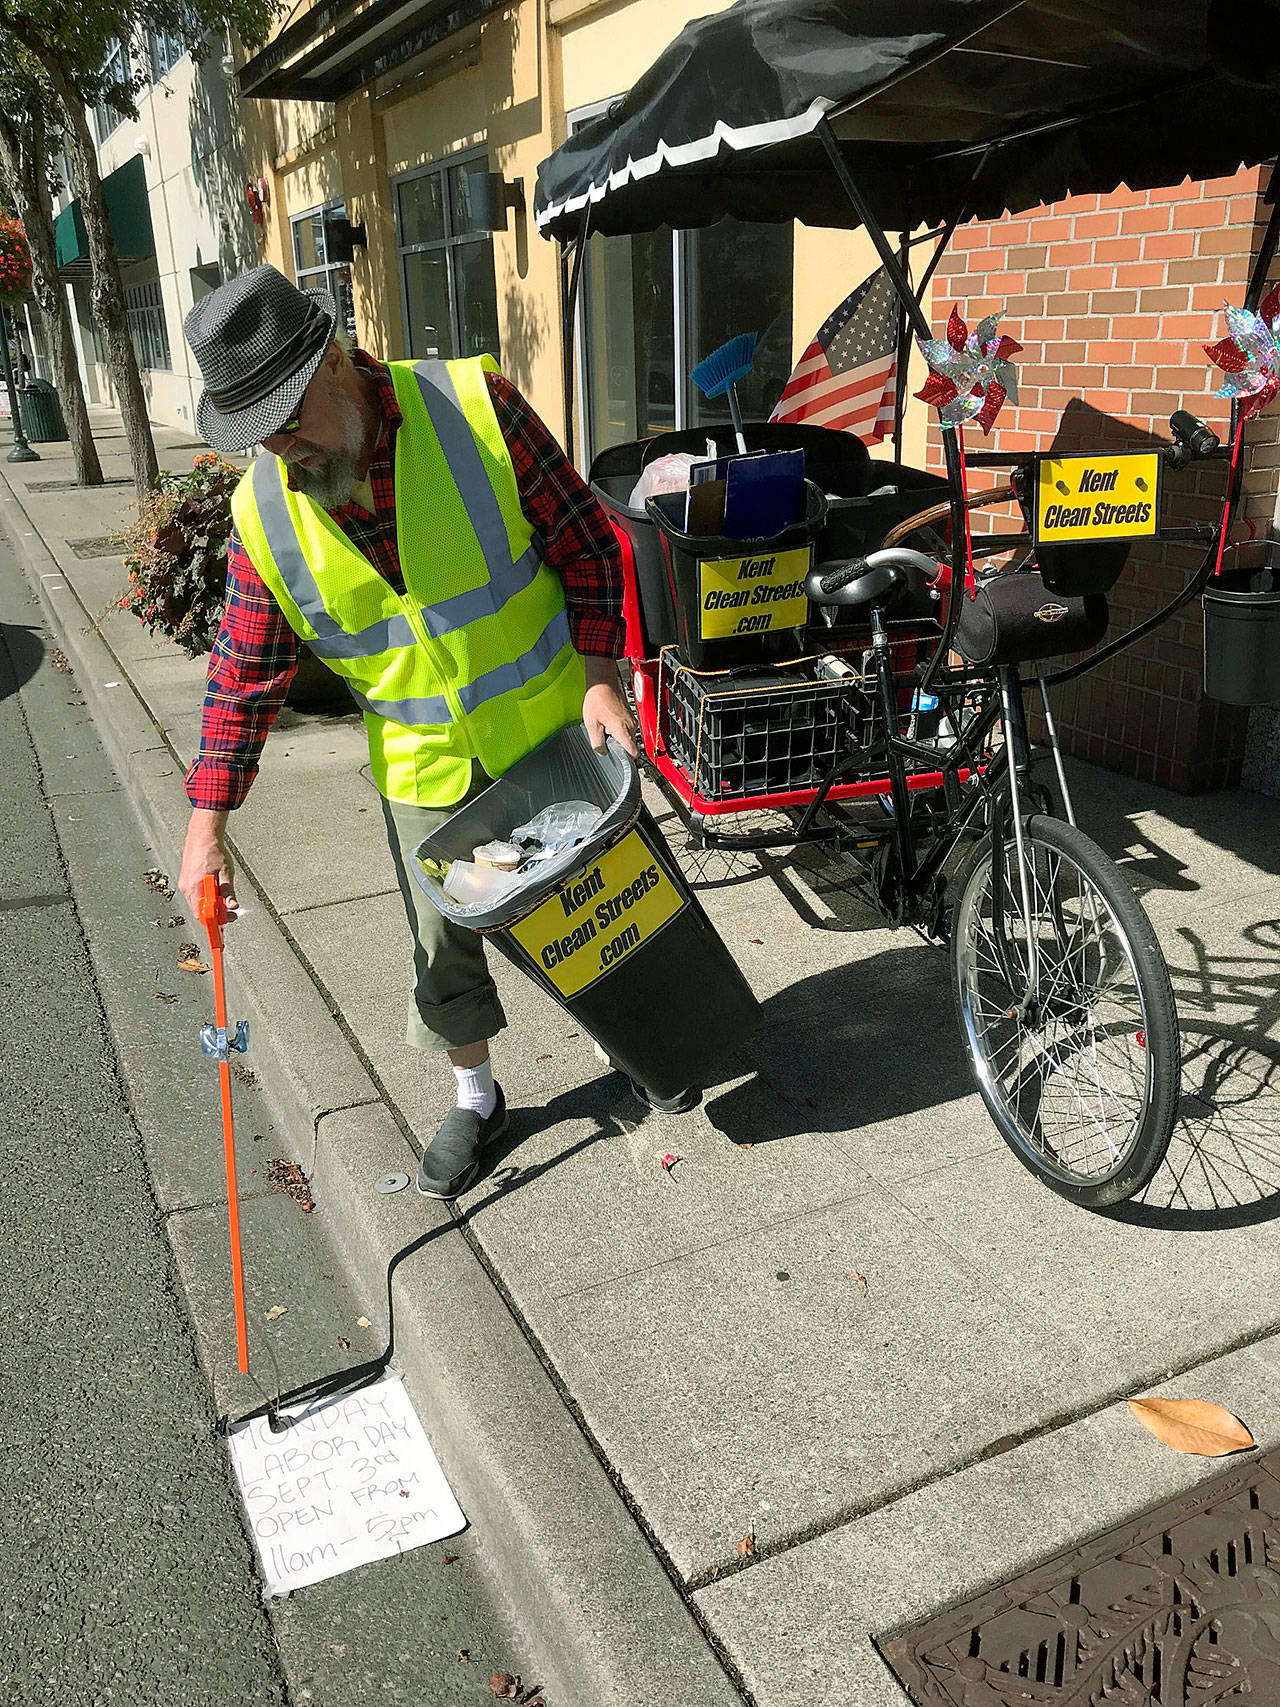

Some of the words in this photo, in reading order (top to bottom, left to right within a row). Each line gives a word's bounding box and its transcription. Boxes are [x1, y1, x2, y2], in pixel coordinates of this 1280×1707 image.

[1078, 469, 1119, 493] Kent
[1044, 504, 1091, 529] Clean
[1092, 501, 1152, 526] Streets
[737, 556, 776, 580] Kent
[704, 589, 750, 611] Clean
[750, 580, 806, 605] Streets
[732, 613, 773, 634] .com
[558, 865, 606, 918] Kent
[540, 917, 598, 970] Clean
[594, 863, 660, 930] Streets
[598, 922, 641, 971] .com
[239, 1435, 361, 1487] LABOR
[362, 1416, 412, 1448] DAY
[247, 1467, 335, 1514] SEPT
[350, 1449, 400, 1484] 3rd
[255, 1499, 334, 1538] OPEN
[350, 1471, 421, 1507] FROM
